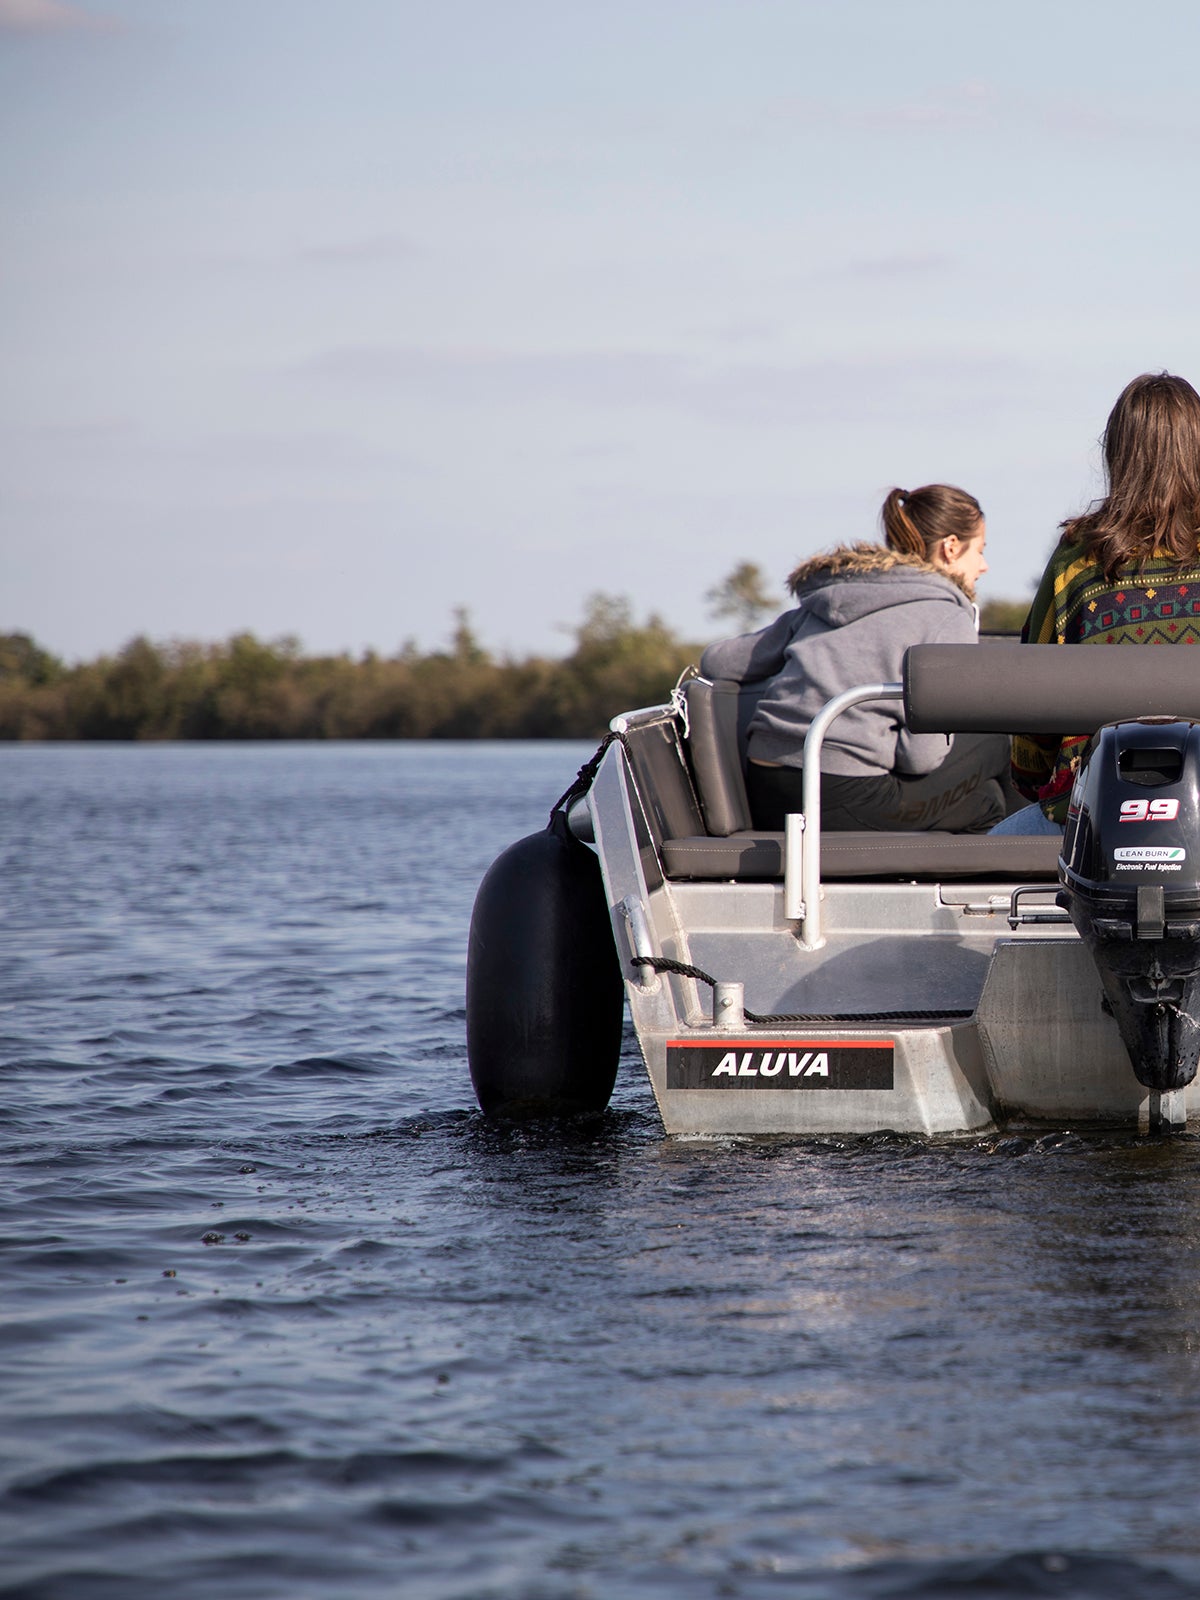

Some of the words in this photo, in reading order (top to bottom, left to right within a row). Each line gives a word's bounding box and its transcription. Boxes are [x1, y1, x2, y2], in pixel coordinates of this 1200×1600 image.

[1119, 798, 1180, 822] 9.9
[1115, 863, 1143, 871] Electronic
[1144, 863, 1157, 871] Fuel
[1157, 863, 1182, 872] Injection
[711, 1052, 829, 1077] ALUVA
